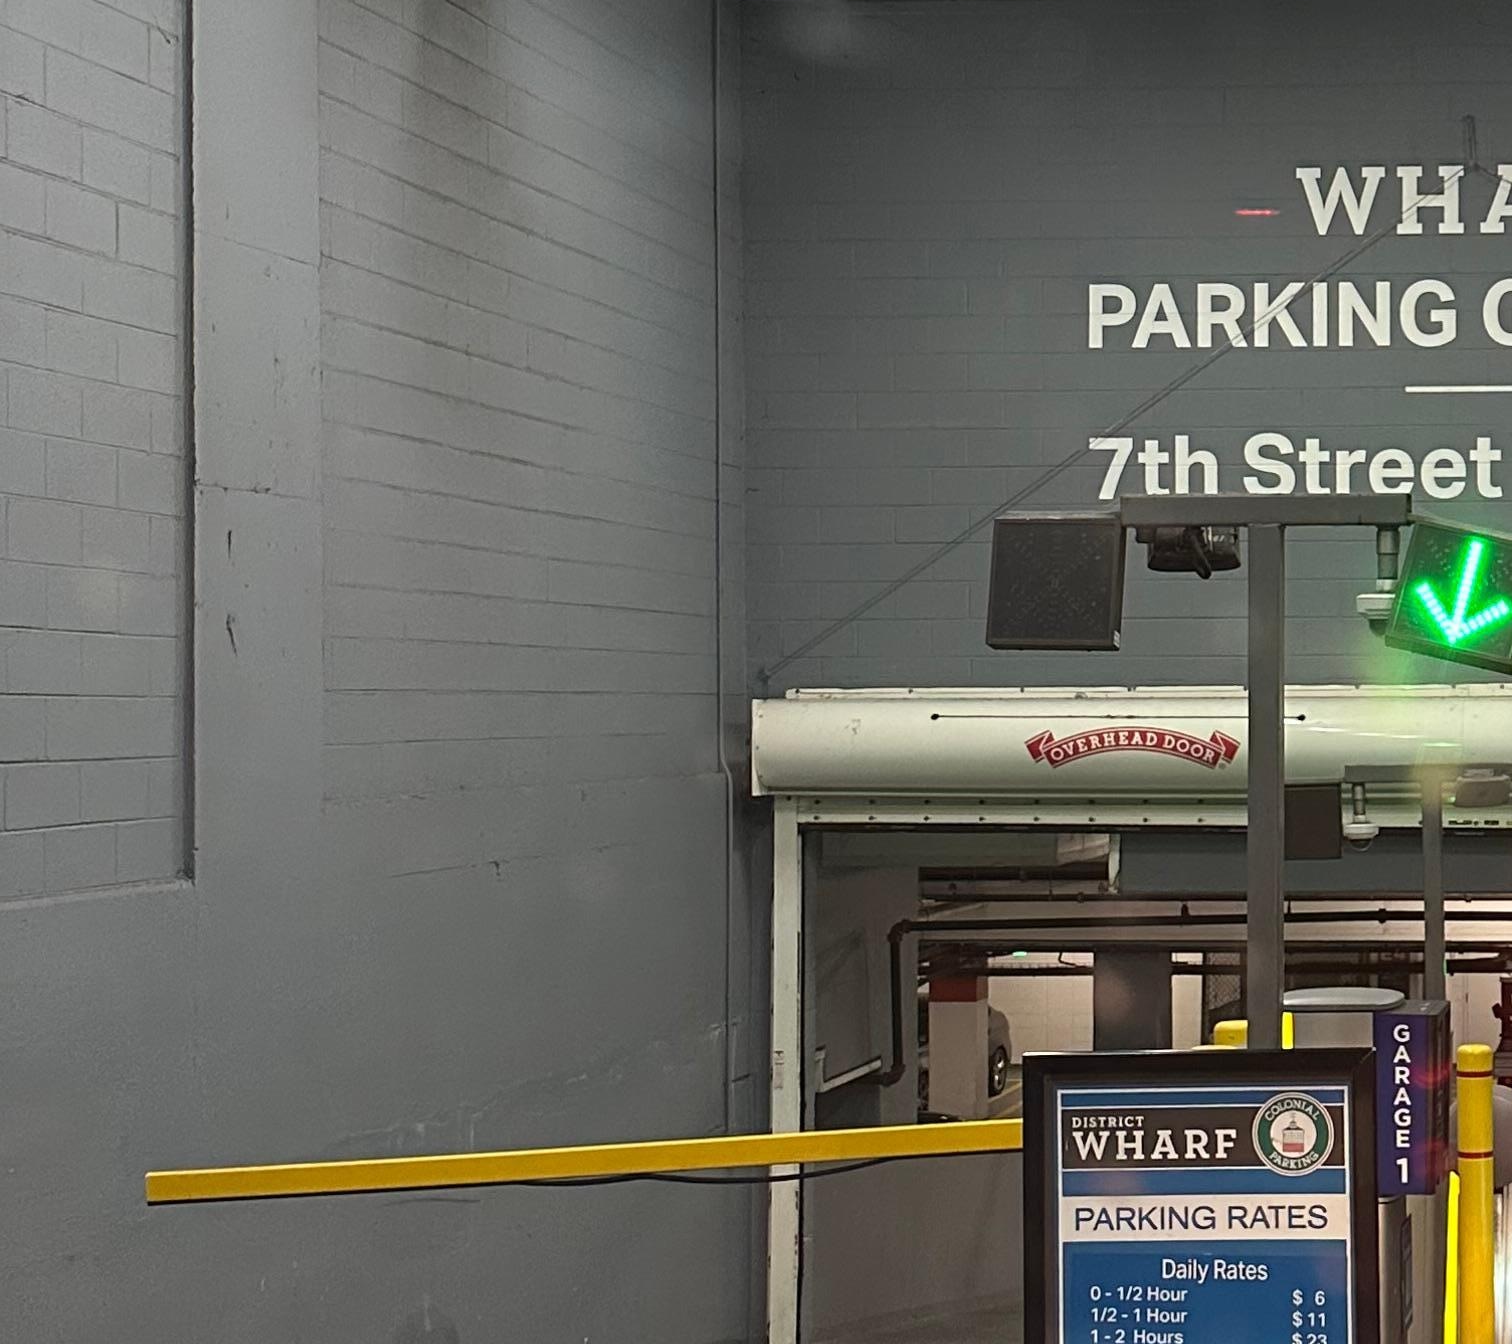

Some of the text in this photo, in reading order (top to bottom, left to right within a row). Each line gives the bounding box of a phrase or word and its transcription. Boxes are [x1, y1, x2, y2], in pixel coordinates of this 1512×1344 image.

[1088, 279, 1457, 349] PARKING
[1088, 434, 1220, 501] 7th
[1242, 431, 1503, 499] Street
[1050, 732, 1215, 763] OVERHEAD DOOR
[1393, 1024, 1411, 1148] GARAGE
[1264, 1099, 1320, 1122] COLONIAL
[1072, 1116, 1144, 1129] DISTRICT
[1072, 1128, 1237, 1160] WHARF
[1269, 1150, 1320, 1169] PARKING
[1075, 1205, 1328, 1231] PARKING RATES
[1162, 1259, 1268, 1284] Daily Rates
[1090, 1286, 1101, 1301] 0
[1117, 1285, 1142, 1301] 1/2
[1147, 1286, 1188, 1301] Hour
[1292, 1288, 1325, 1306] $ 6
[1091, 1307, 1117, 1322] 1/2
[1133, 1308, 1140, 1322] 1
[1147, 1308, 1188, 1323] Hour
[1292, 1310, 1325, 1328] $ 11
[1091, 1329, 1098, 1344] 1
[1115, 1329, 1125, 1344] 2
[1134, 1329, 1183, 1344] Hours
